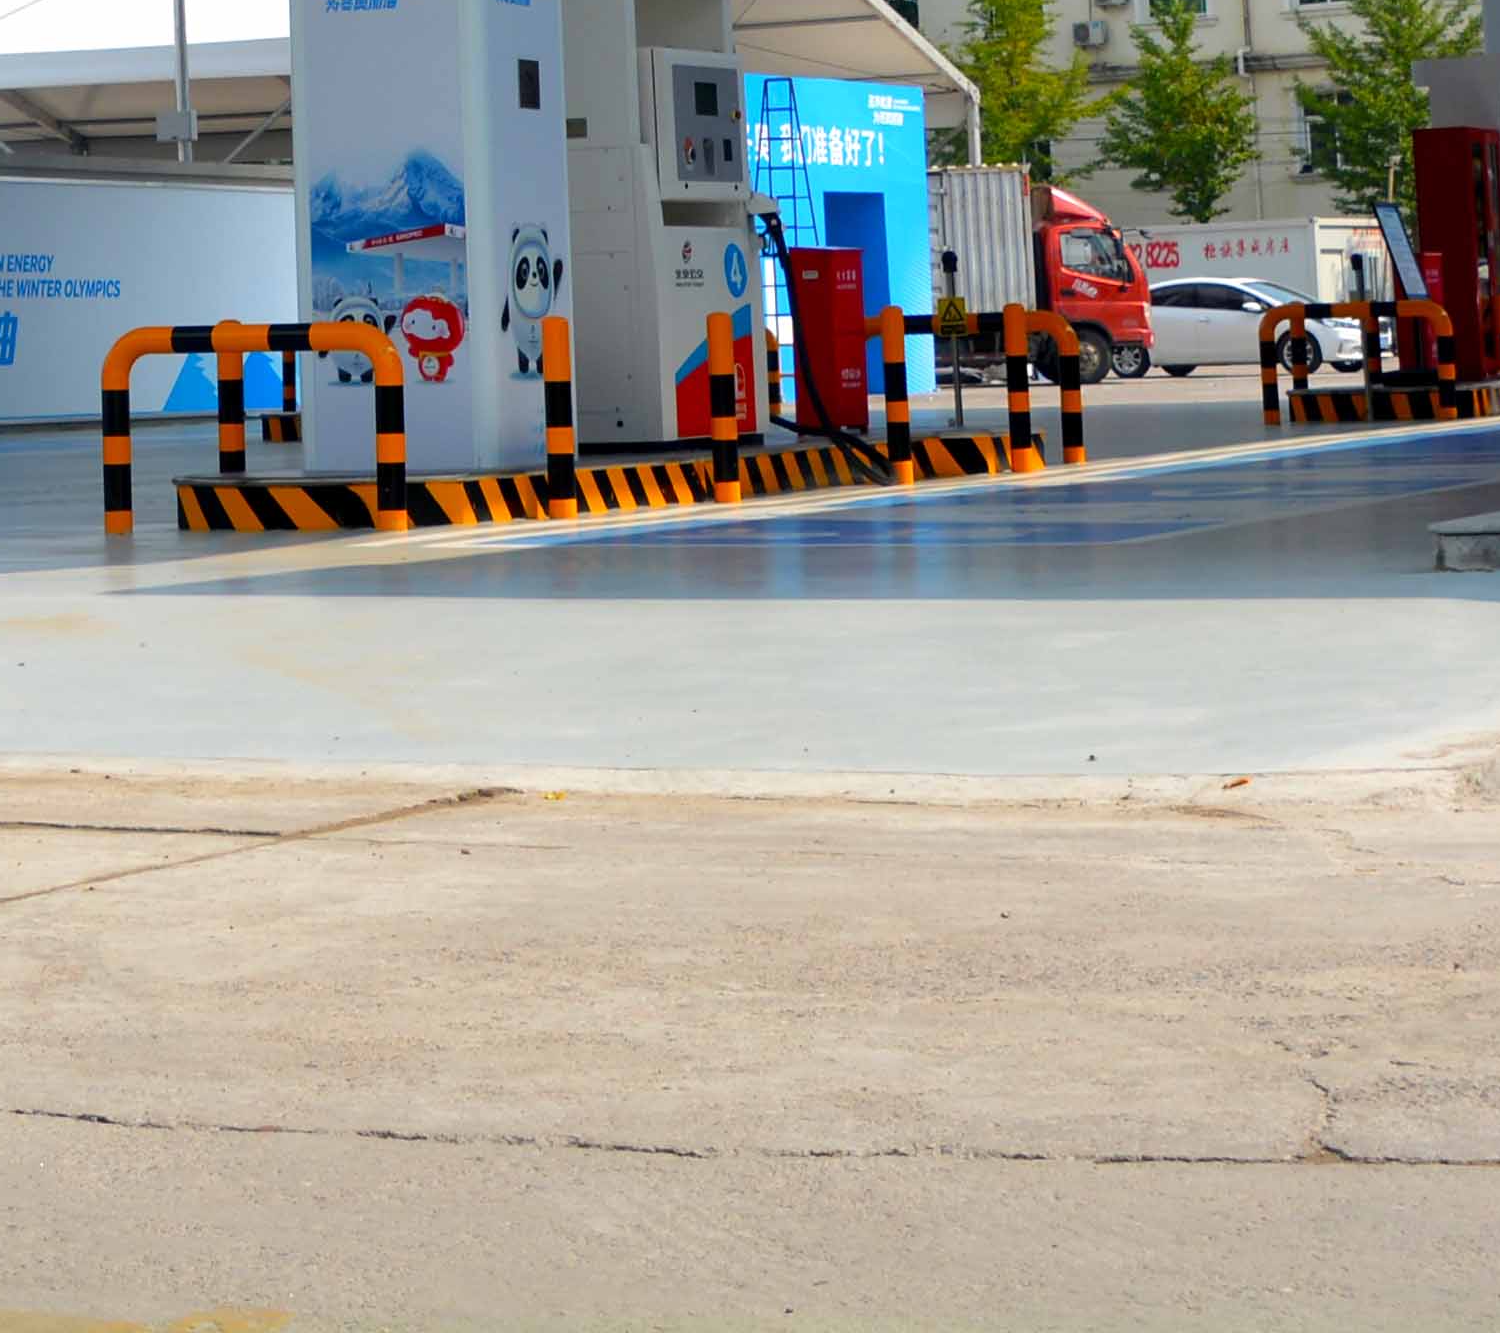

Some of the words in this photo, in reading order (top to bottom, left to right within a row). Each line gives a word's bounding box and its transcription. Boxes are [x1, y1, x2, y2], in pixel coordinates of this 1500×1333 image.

[7, 253, 54, 273] ENERGY
[1145, 240, 1180, 269] 8225
[730, 251, 743, 290] 4
[15, 279, 62, 299] WINTER
[63, 279, 121, 299] OLYMPICS
